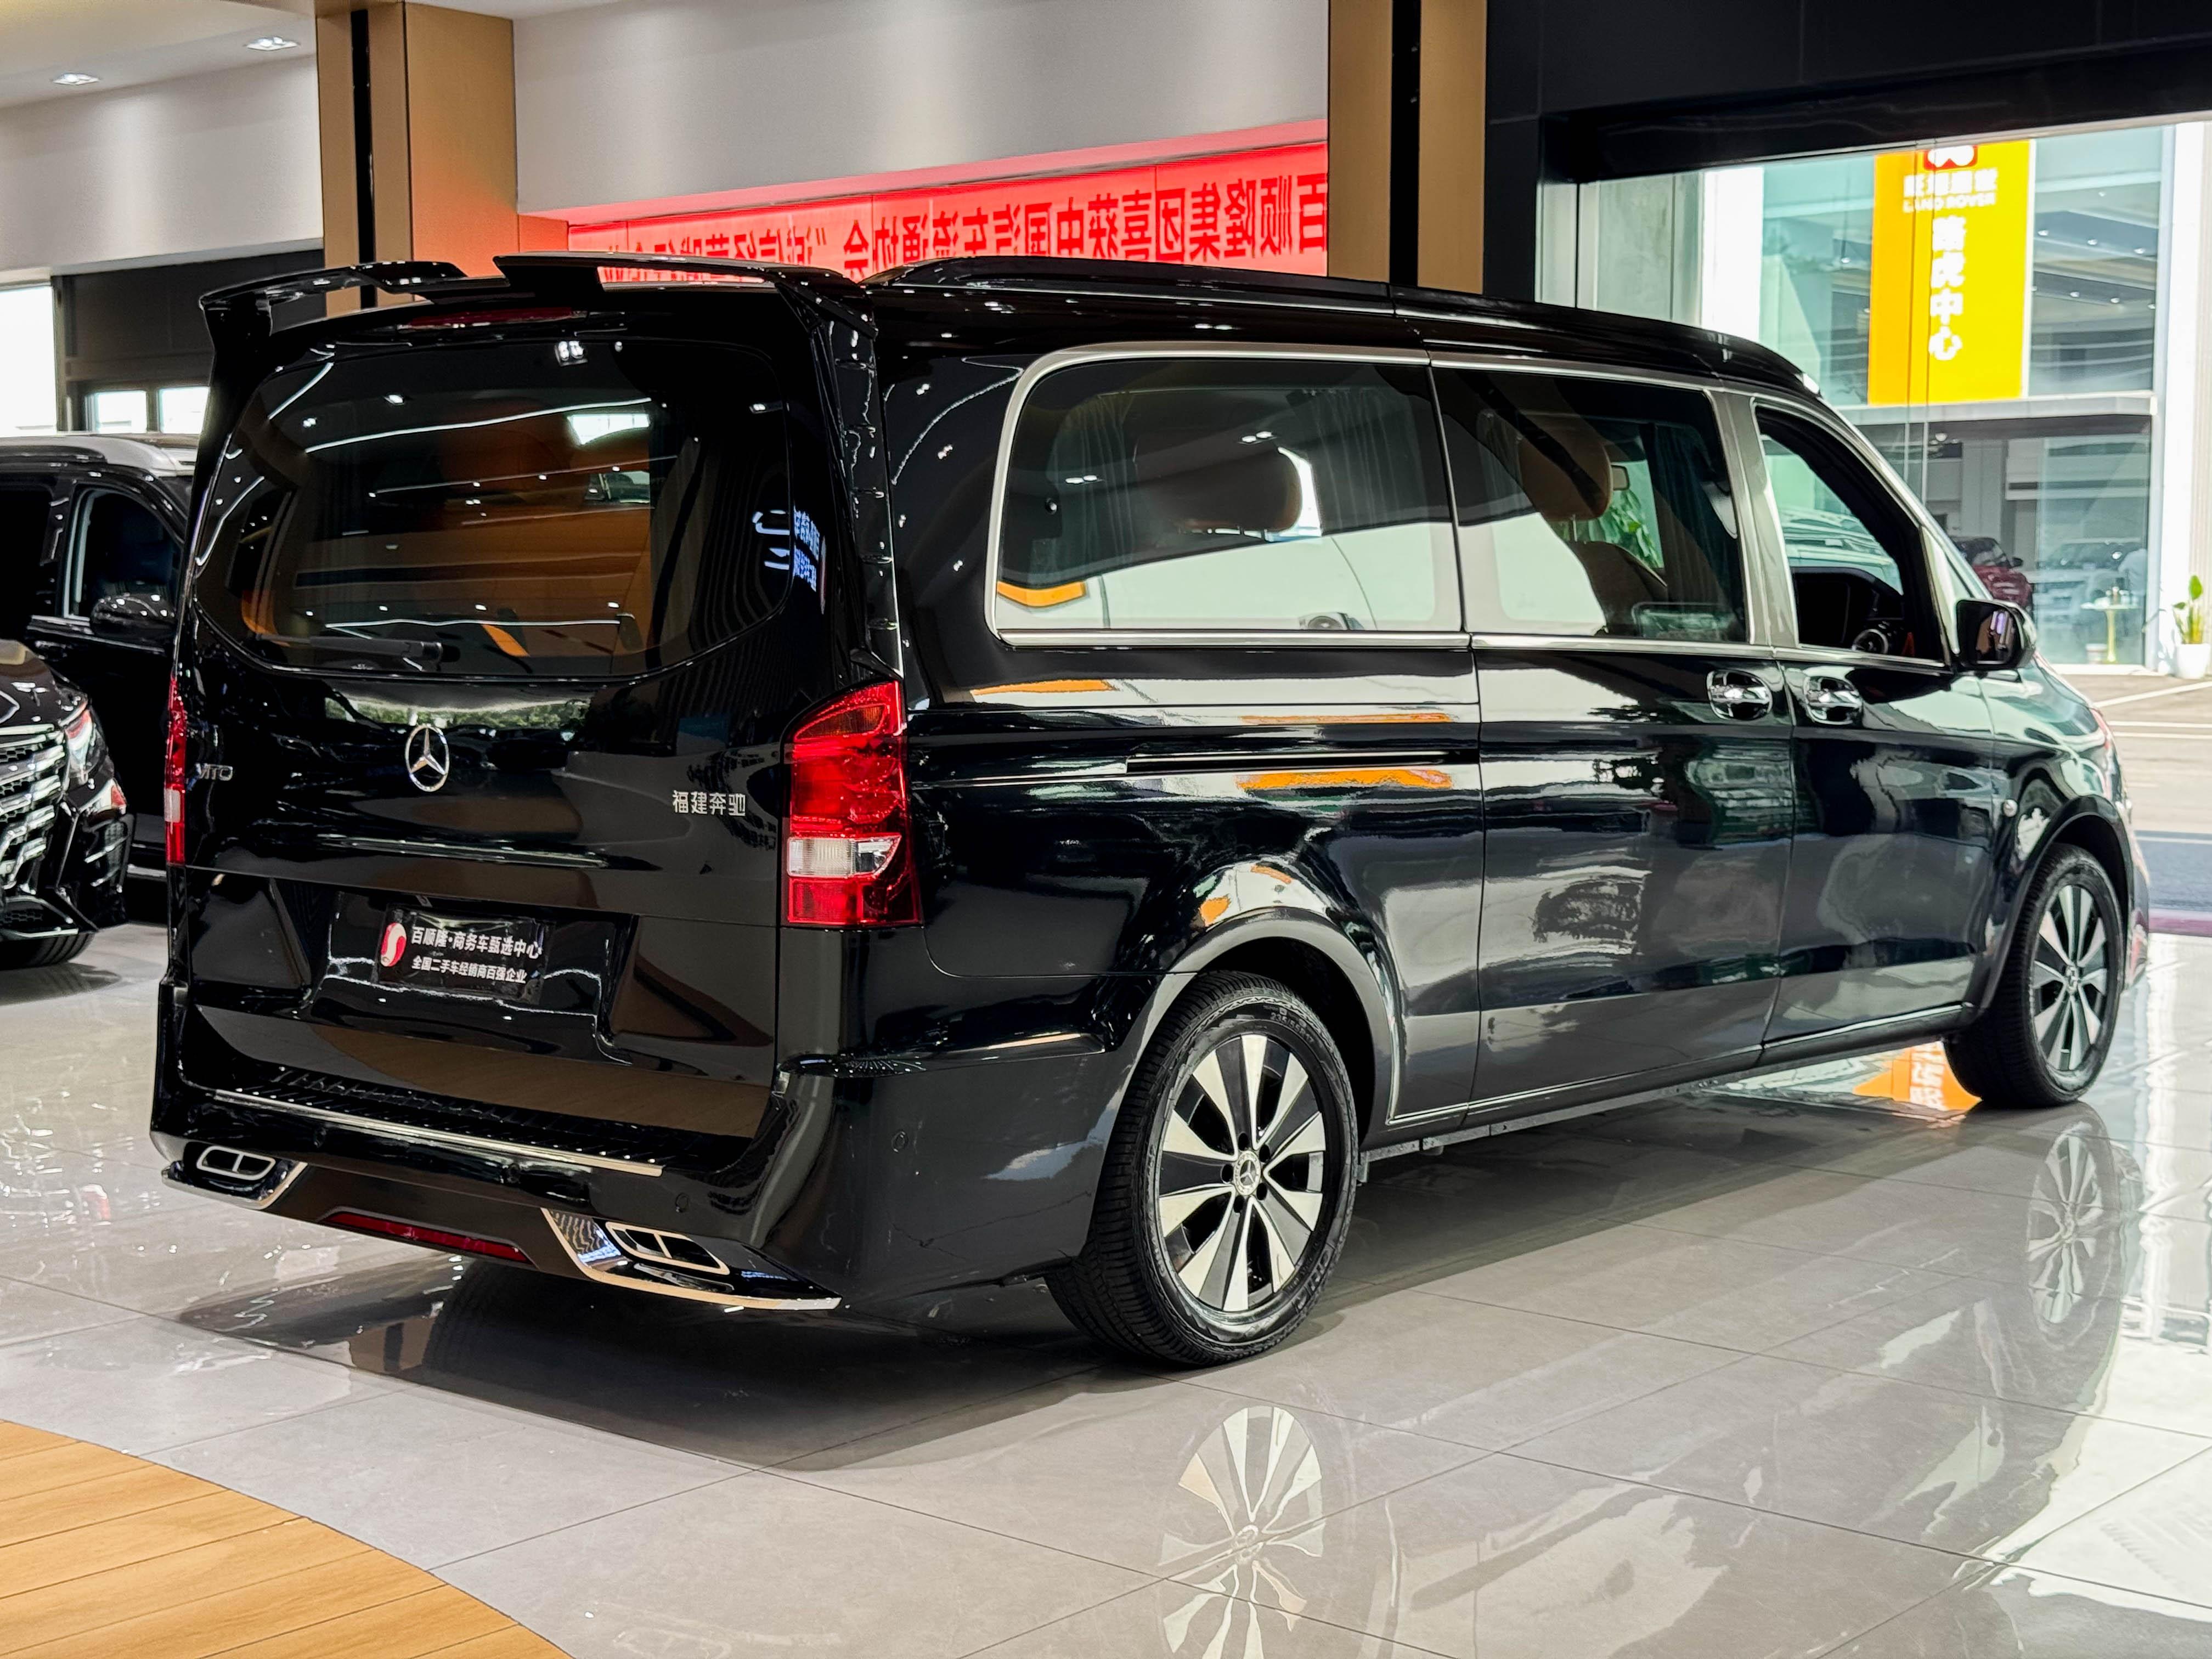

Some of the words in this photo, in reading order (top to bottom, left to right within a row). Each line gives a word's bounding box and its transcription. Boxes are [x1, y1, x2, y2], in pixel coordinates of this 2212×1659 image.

[673, 790, 746, 816] 福建奔驰
[411, 955, 527, 984] 全国二手车经销商百强企业
